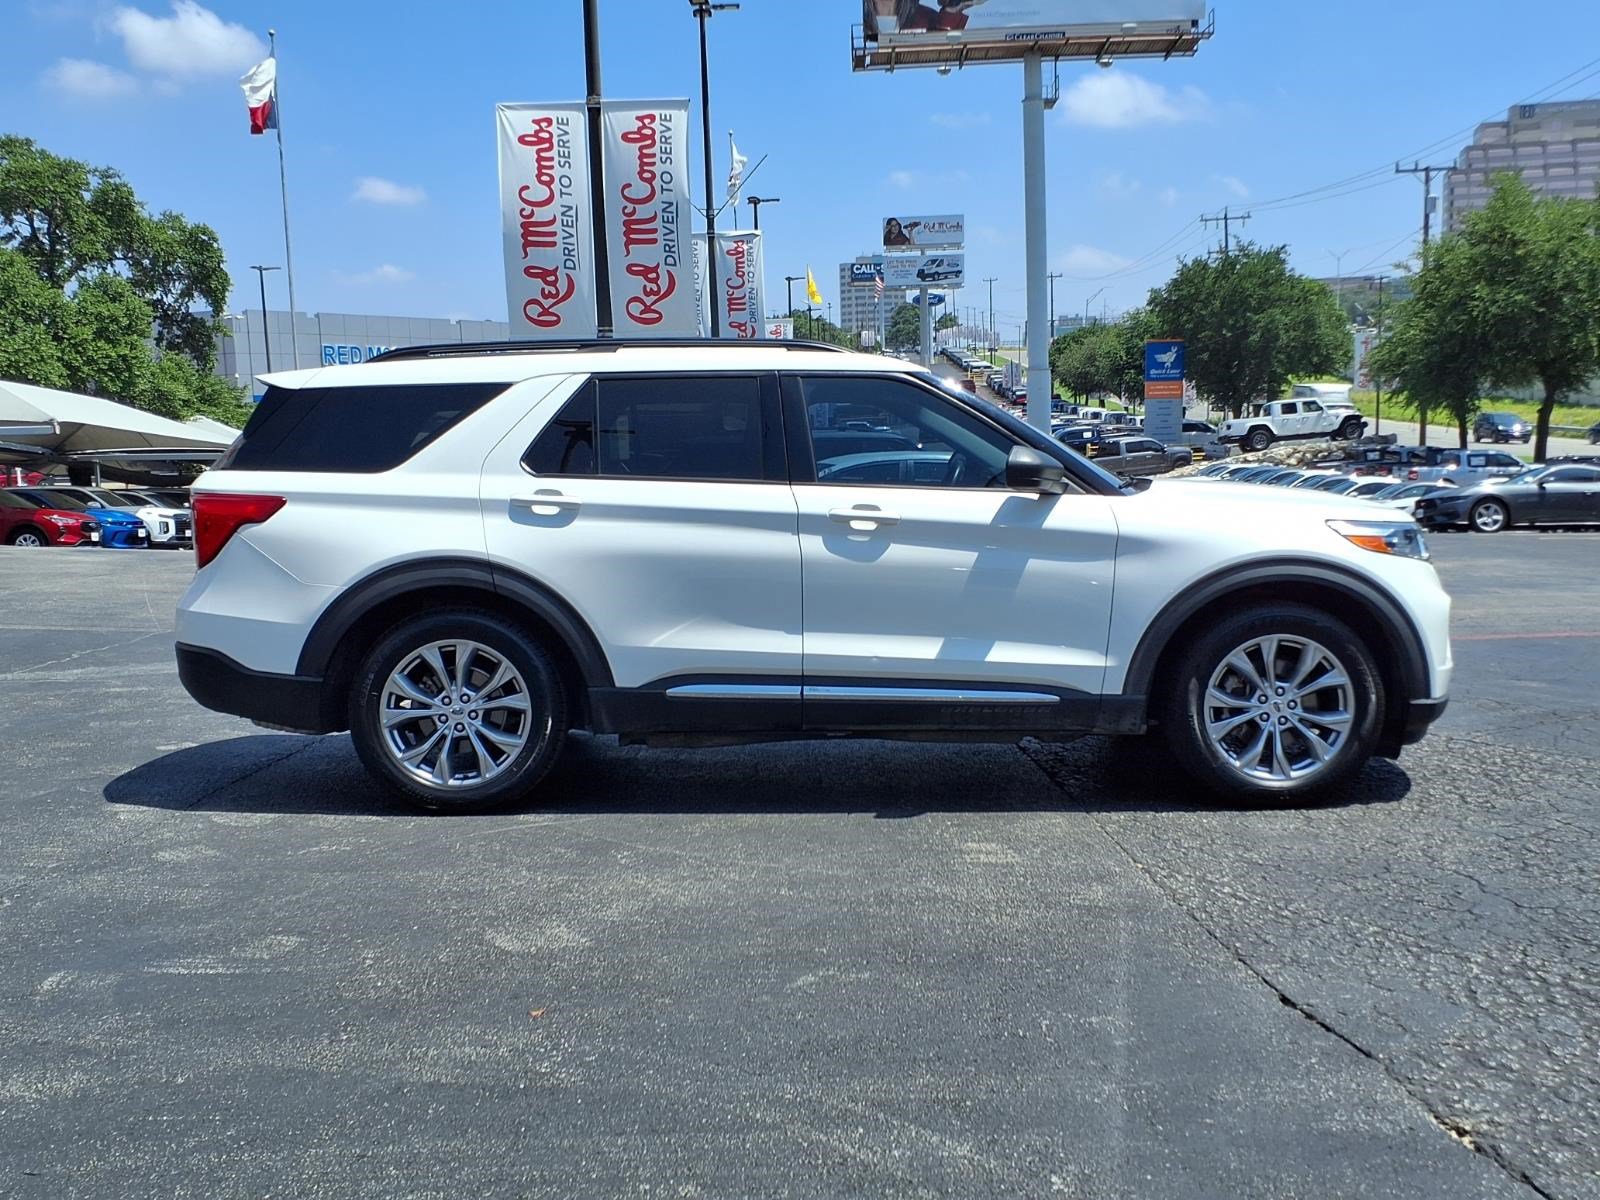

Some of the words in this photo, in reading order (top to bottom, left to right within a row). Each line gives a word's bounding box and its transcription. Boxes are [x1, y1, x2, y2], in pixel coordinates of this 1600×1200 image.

[556, 116, 571, 170] SERVE
[658, 112, 673, 166] SERVE
[517, 116, 557, 260] McCombs
[559, 174, 574, 200] TO
[620, 113, 659, 257] McCombs
[660, 171, 674, 197] TO
[562, 204, 577, 271] DRIVEN
[662, 201, 677, 267] DRIVEN
[747, 239, 755, 269] SERVE
[522, 265, 576, 328] Red
[625, 262, 676, 326] Red
[726, 239, 746, 318] McCombs
[747, 271, 755, 284] TO
[748, 288, 757, 323] DRIVEN
[323, 345, 363, 365] RED
